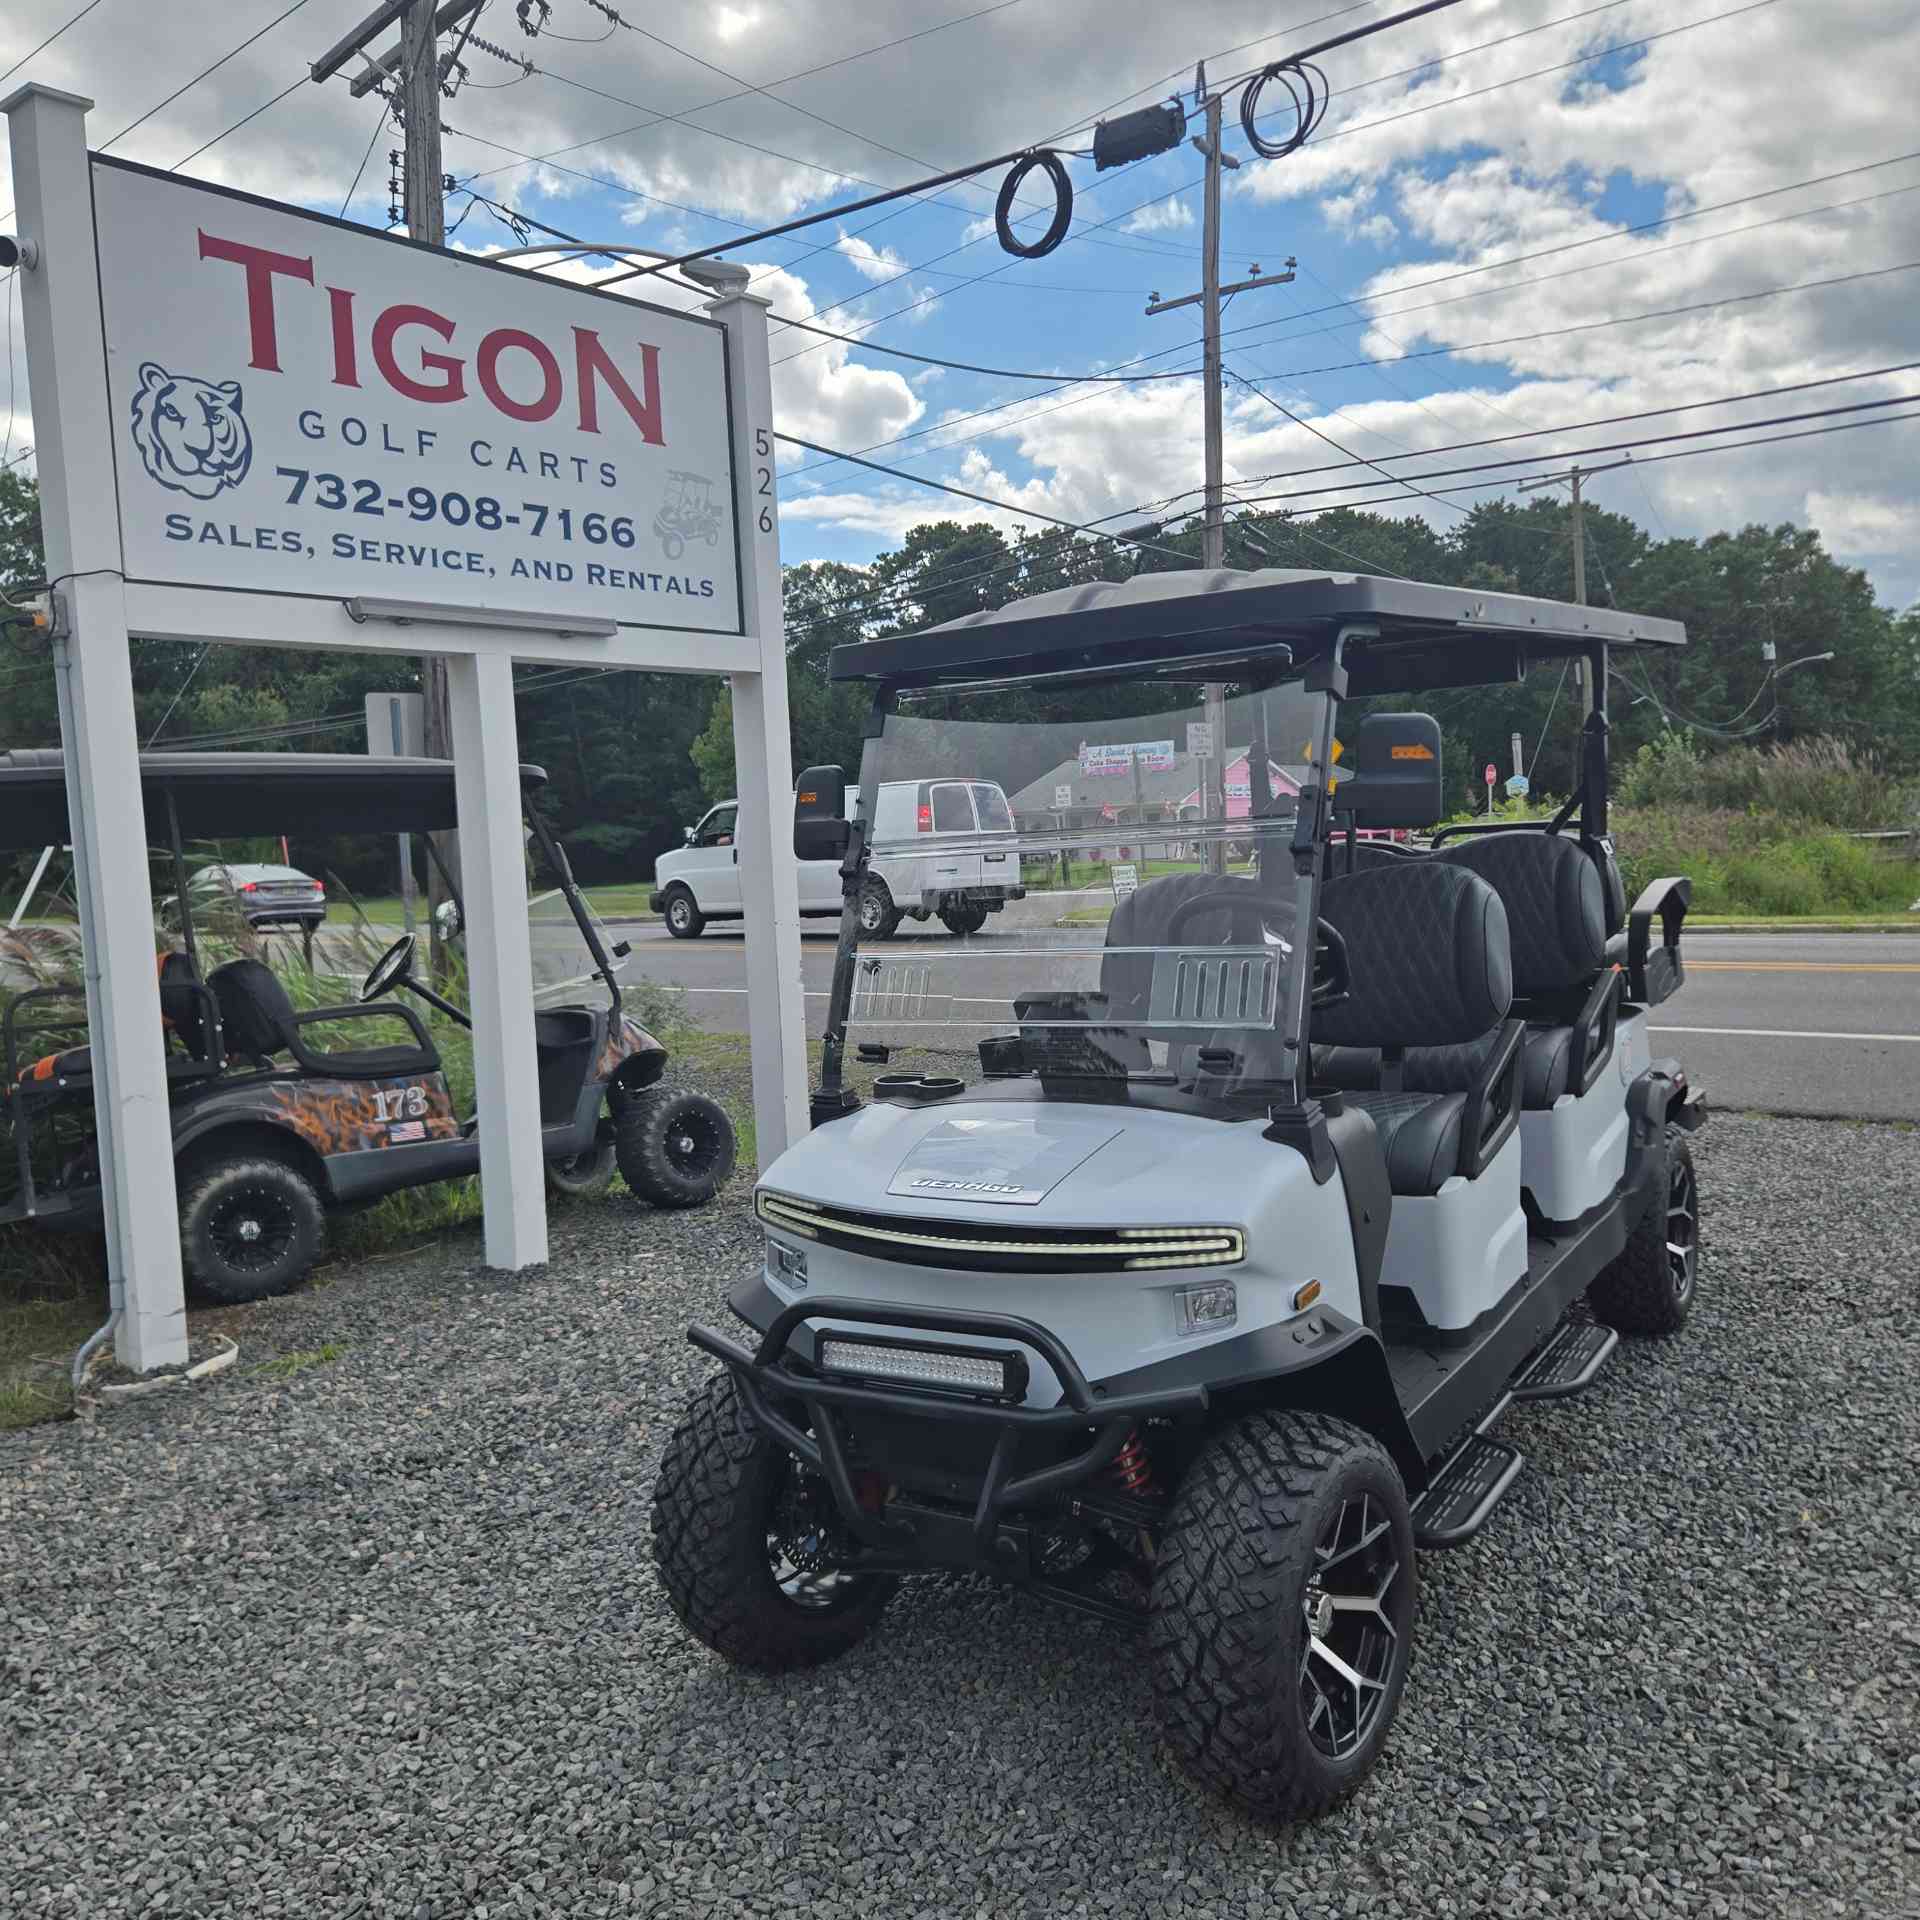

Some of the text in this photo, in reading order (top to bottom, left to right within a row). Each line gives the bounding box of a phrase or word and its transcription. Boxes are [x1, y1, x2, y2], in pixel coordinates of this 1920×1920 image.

[198, 228, 667, 447] TIGON
[299, 411, 618, 488] GOLF CARTS
[756, 428, 772, 533] 526
[275, 466, 636, 549] 732-908-7166
[165, 513, 714, 598] SALES, SERVICE, AND RENTALS
[371, 1085, 429, 1122] 173
